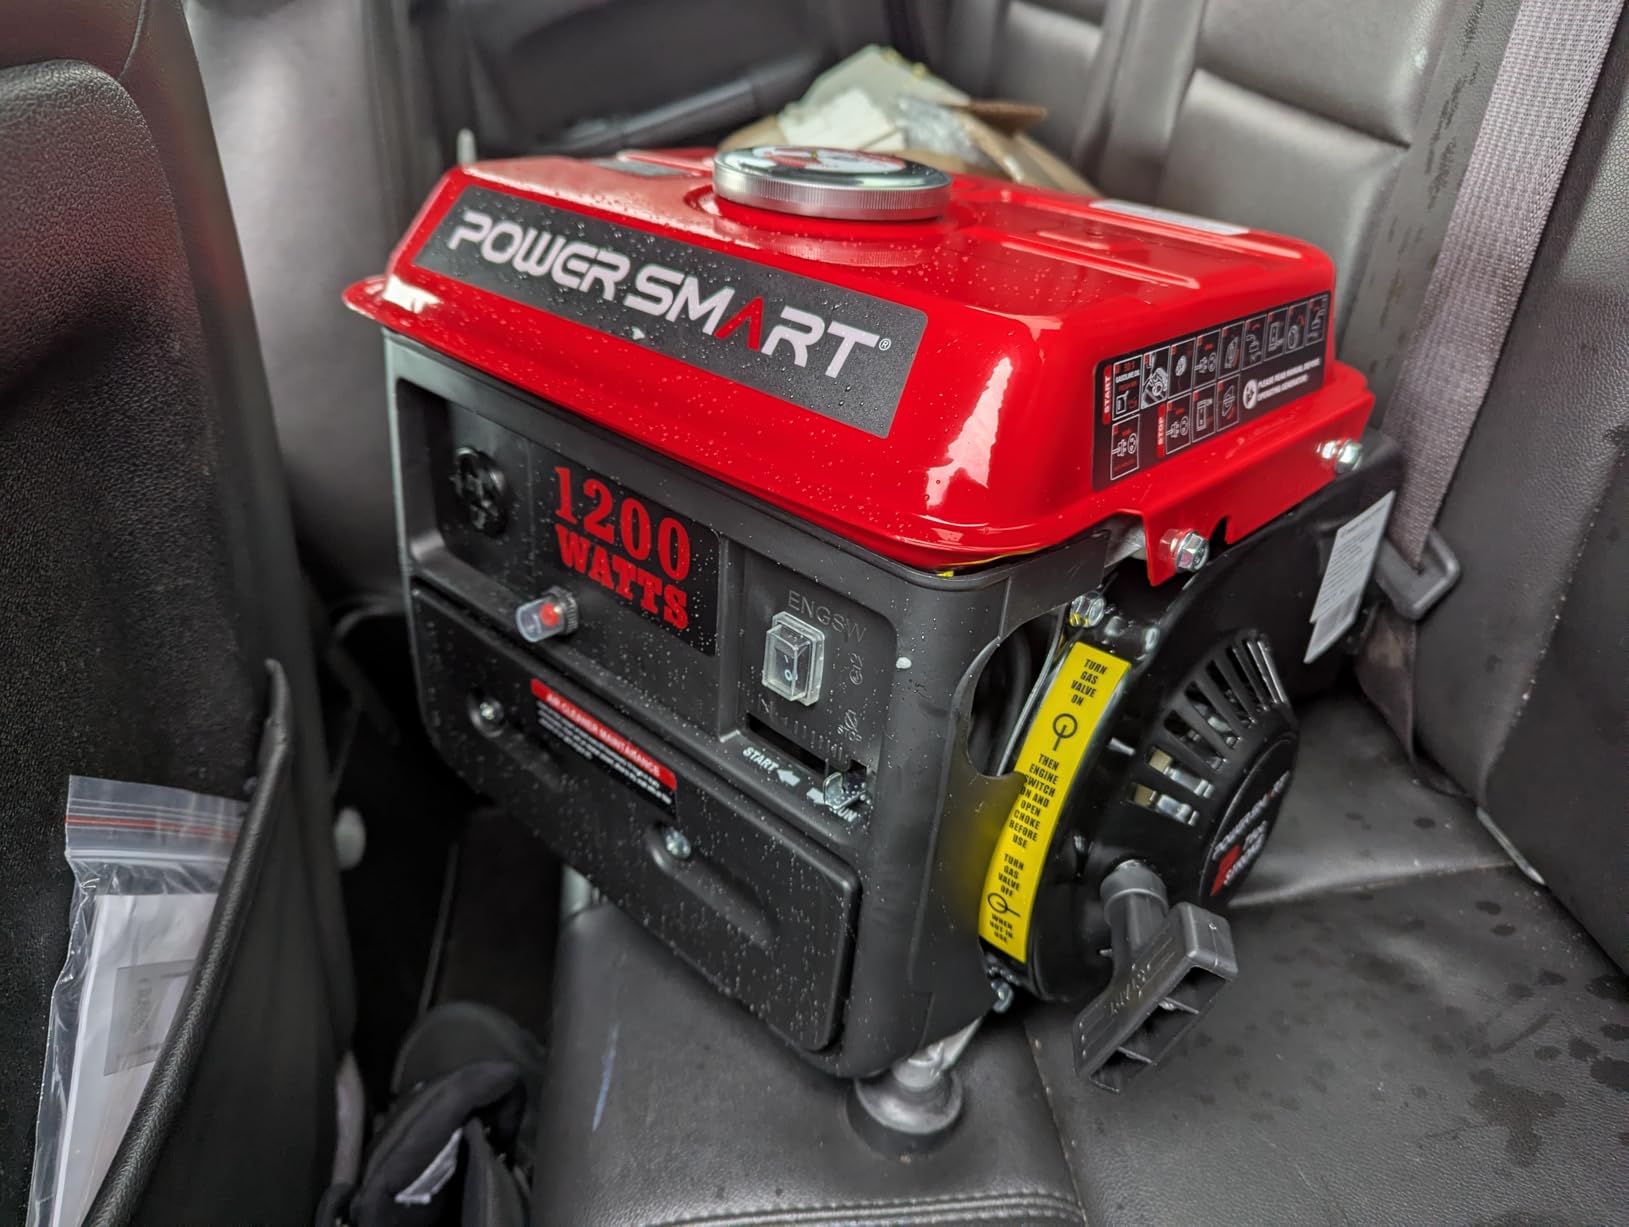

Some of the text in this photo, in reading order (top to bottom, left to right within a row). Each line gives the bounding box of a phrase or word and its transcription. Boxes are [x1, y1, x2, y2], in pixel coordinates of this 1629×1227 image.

[448, 211, 631, 300] POWER
[1104, 375, 1112, 413] START
[555, 467, 690, 581] 1200
[555, 523, 688, 630] WATTS
[1084, 658, 1108, 675] TURN
[1080, 671, 1098, 685] GAS
[1071, 680, 1096, 698] VALVE
[1071, 694, 1084, 706] ON
[743, 747, 779, 771] START
[1039, 753, 1059, 770] THEN
[1029, 763, 1059, 784] ENGINE
[1026, 775, 1056, 797] SWITCH
[1020, 786, 1050, 807] ON AND
[1020, 800, 1041, 817] OPEN
[1014, 809, 1040, 830] CHOKE
[1009, 819, 1038, 842] BEFORE
[1012, 834, 1028, 849] USE
[1003, 853, 1024, 871] TURN
[998, 872, 1020, 891] VALVE
[1003, 865, 1019, 879] GAS
[1001, 885, 1013, 897] OFF
